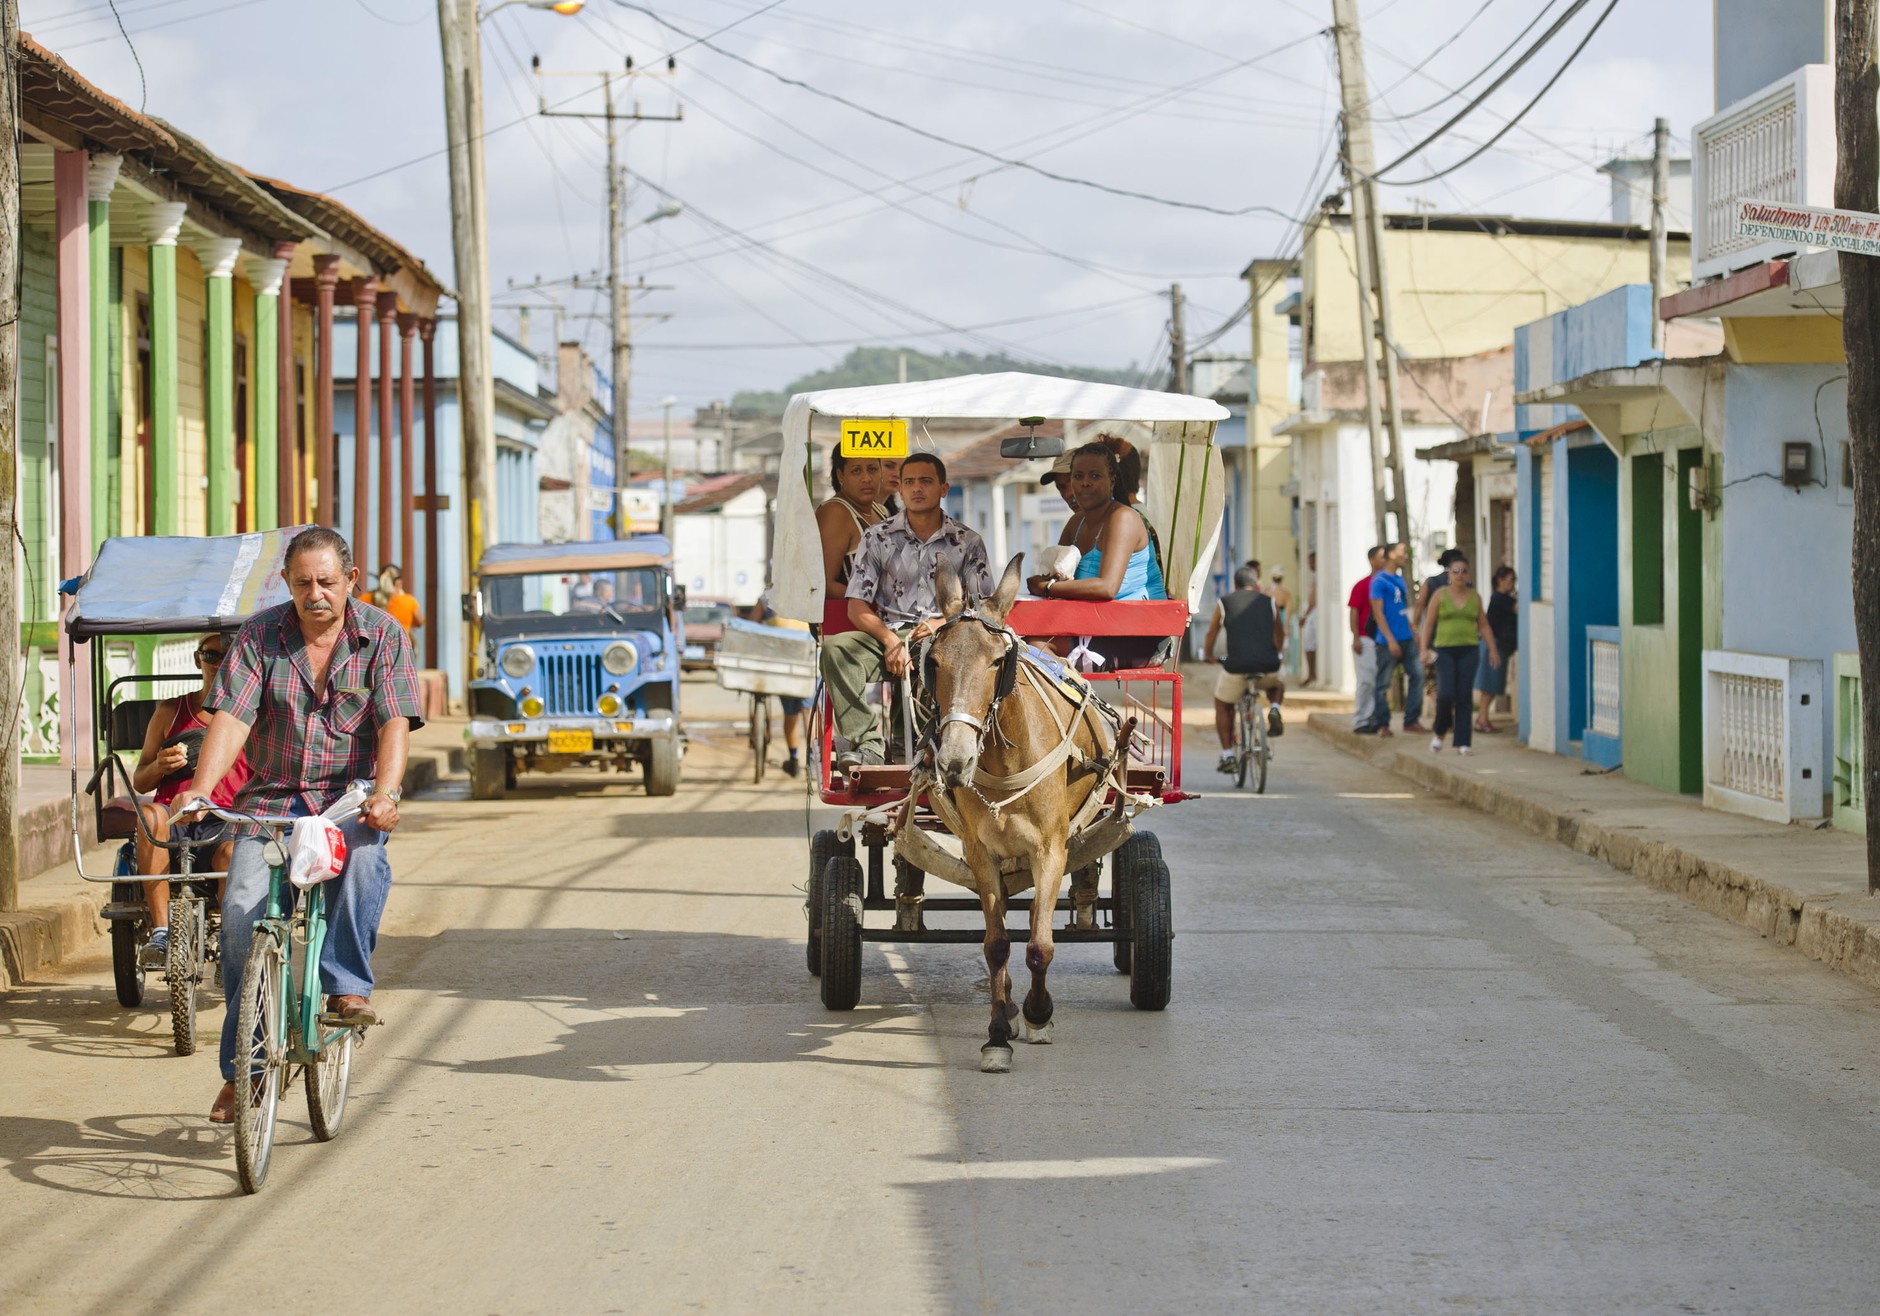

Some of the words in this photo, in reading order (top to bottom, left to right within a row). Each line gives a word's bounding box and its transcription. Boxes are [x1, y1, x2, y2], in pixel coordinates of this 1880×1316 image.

[1740, 203, 1811, 229] Saludamos
[1831, 214, 1851, 233] 500
[1739, 223, 1813, 243] DEFENDIENDO
[1815, 234, 1829, 246] EL
[1830, 235, 1880, 252] SOCIALISM
[847, 431, 892, 448] TAXI
